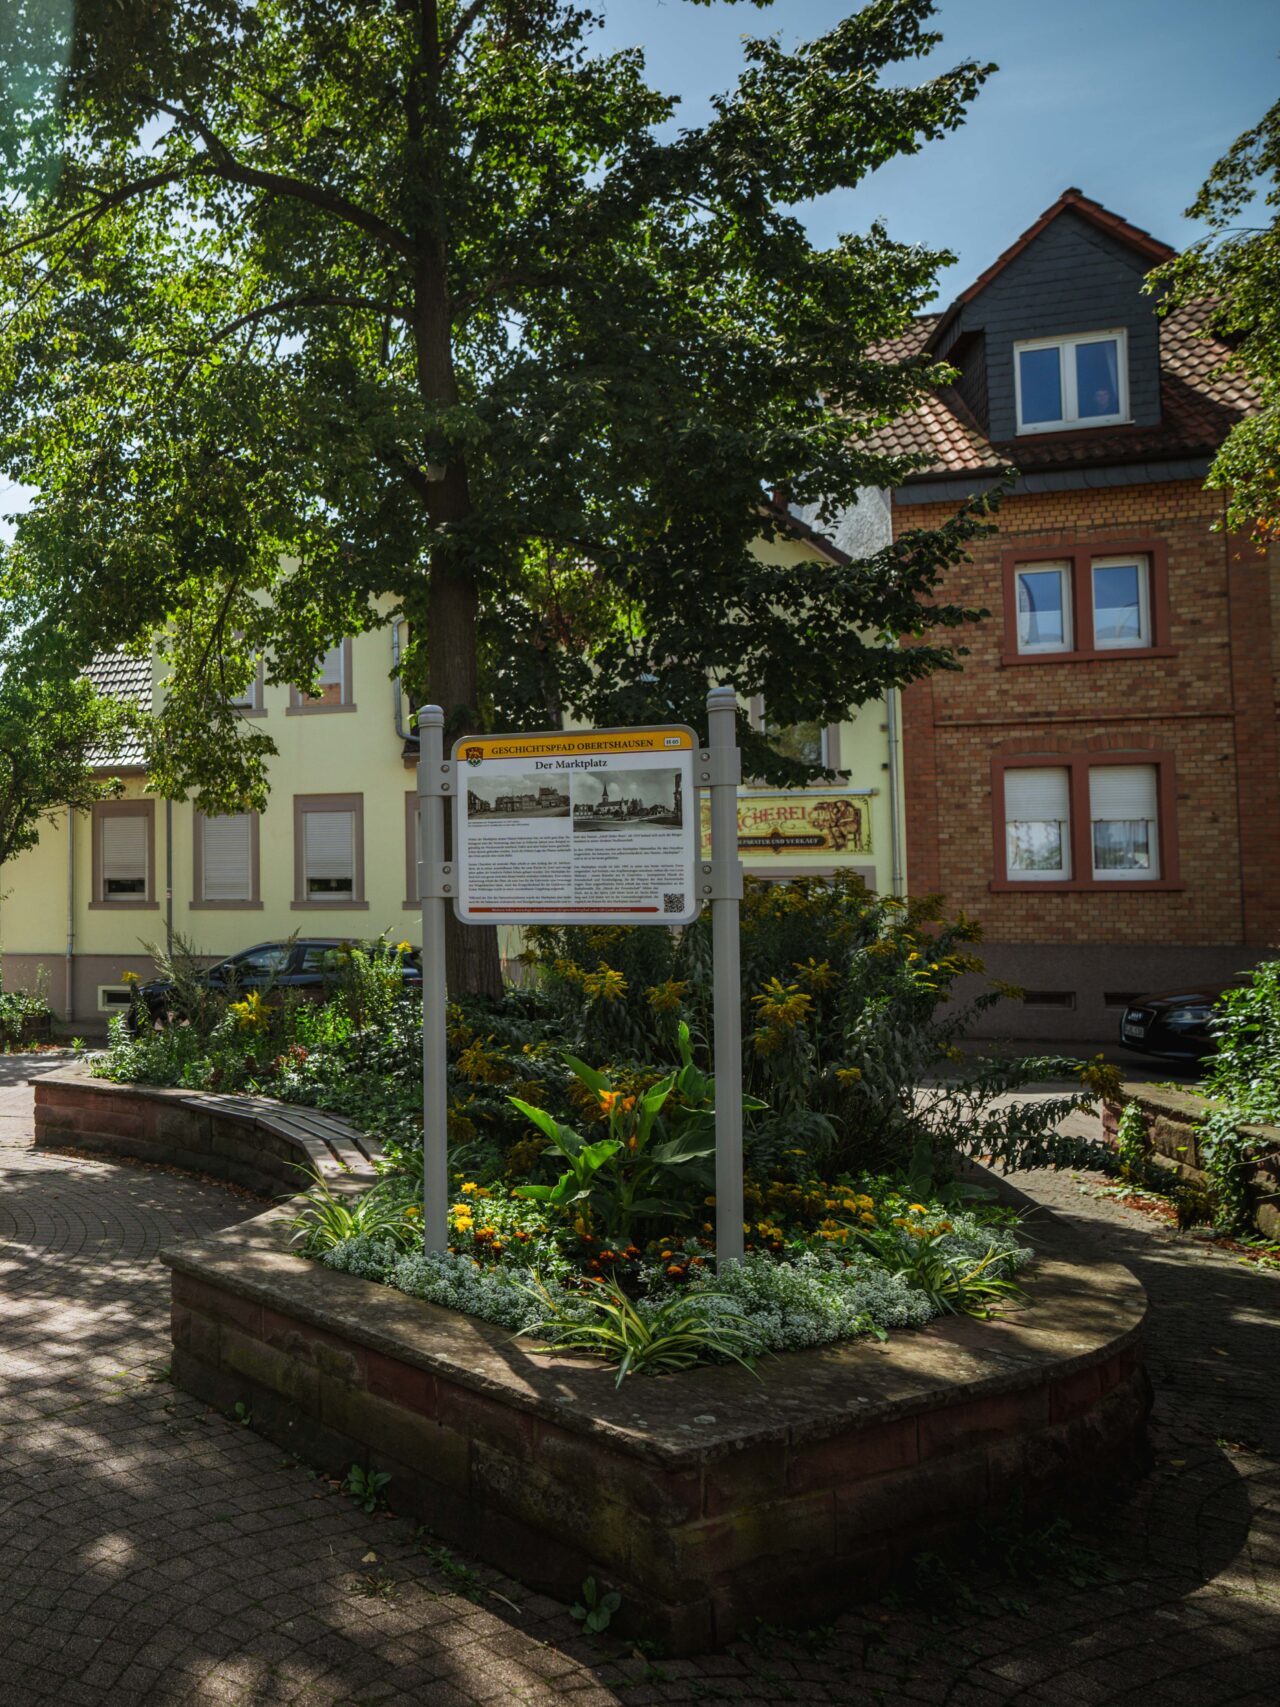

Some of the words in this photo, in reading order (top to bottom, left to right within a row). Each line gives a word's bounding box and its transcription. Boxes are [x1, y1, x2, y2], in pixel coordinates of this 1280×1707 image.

[491, 743, 575, 756] GESCHICHTSPFAD
[576, 739, 654, 752] OBERTSHAUSEN
[535, 760, 553, 770] Der
[555, 757, 608, 772] Marktplatz
